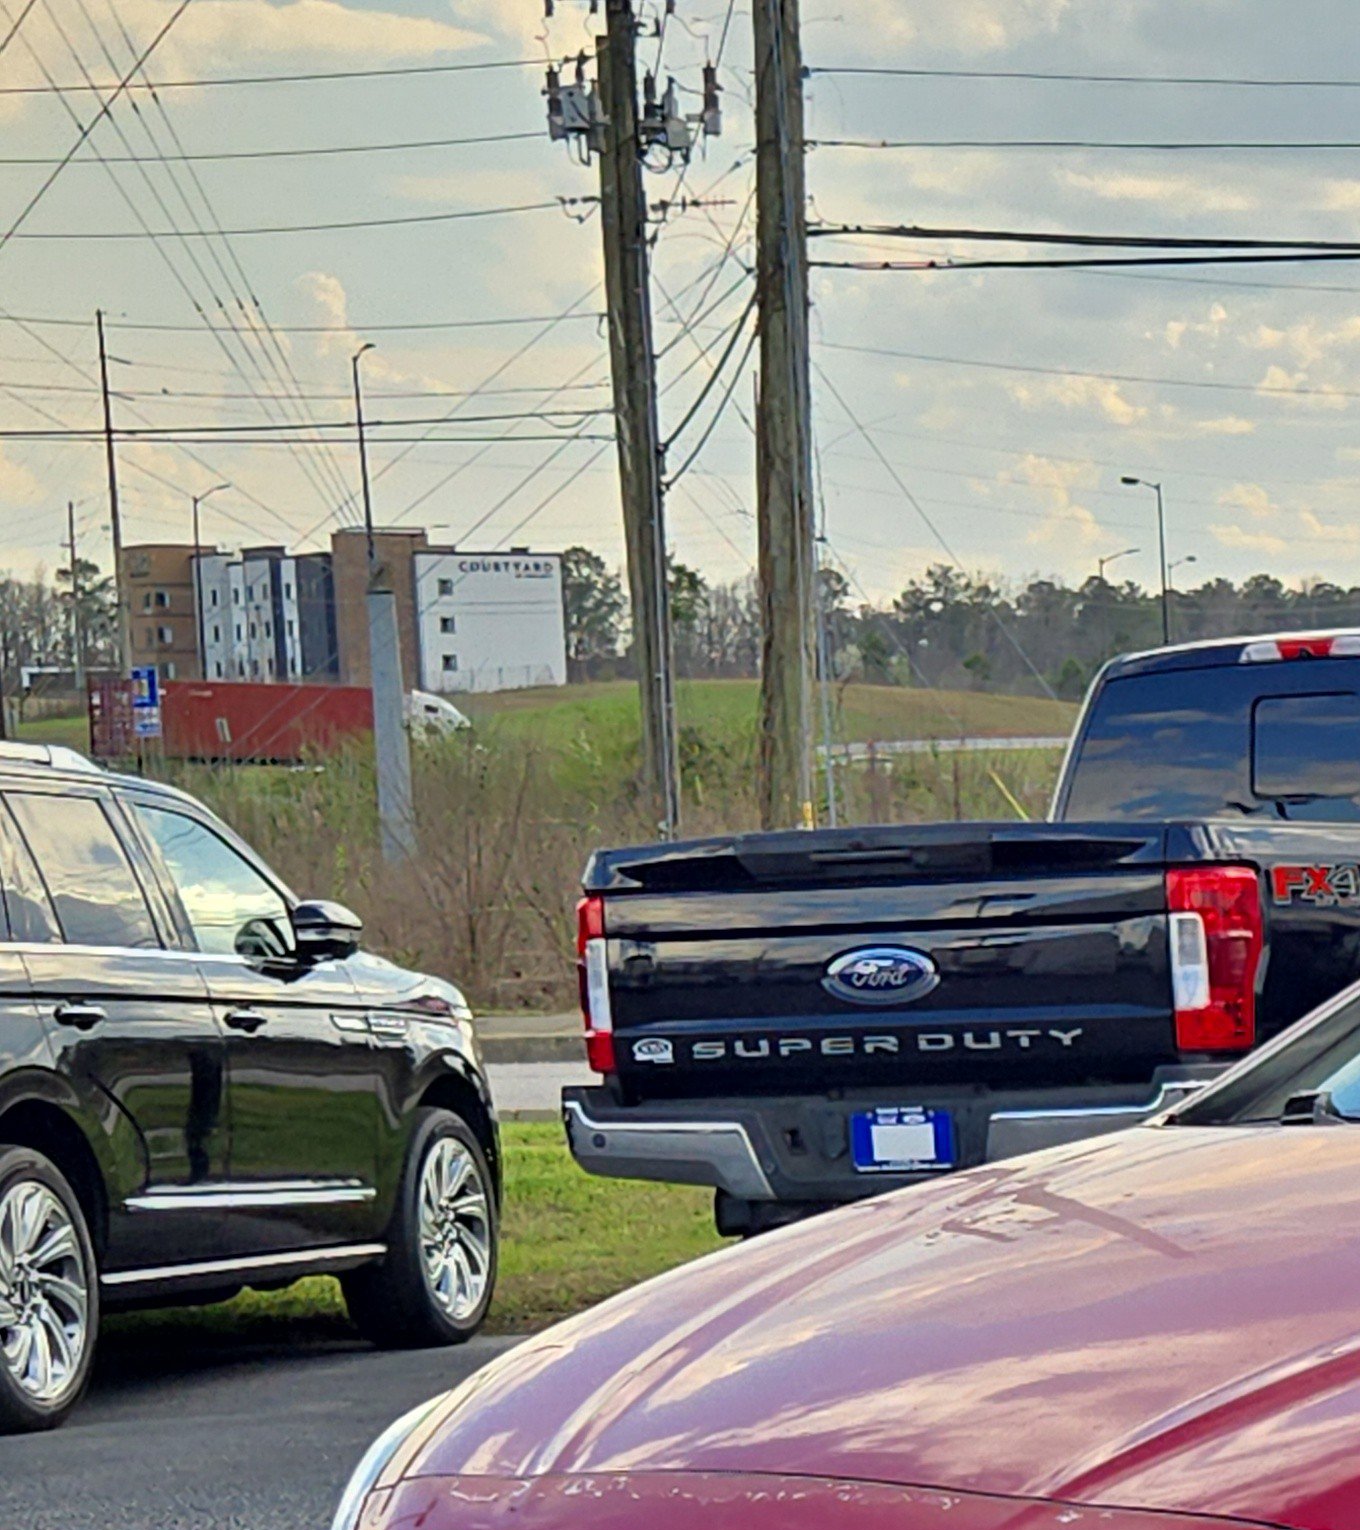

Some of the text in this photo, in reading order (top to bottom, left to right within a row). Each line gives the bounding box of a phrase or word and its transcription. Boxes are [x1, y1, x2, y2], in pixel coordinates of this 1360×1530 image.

[458, 561, 554, 573] COURTYARD
[843, 959, 917, 988] Ford
[691, 1034, 900, 1060] SUPER
[916, 1027, 1083, 1051] DUTY
